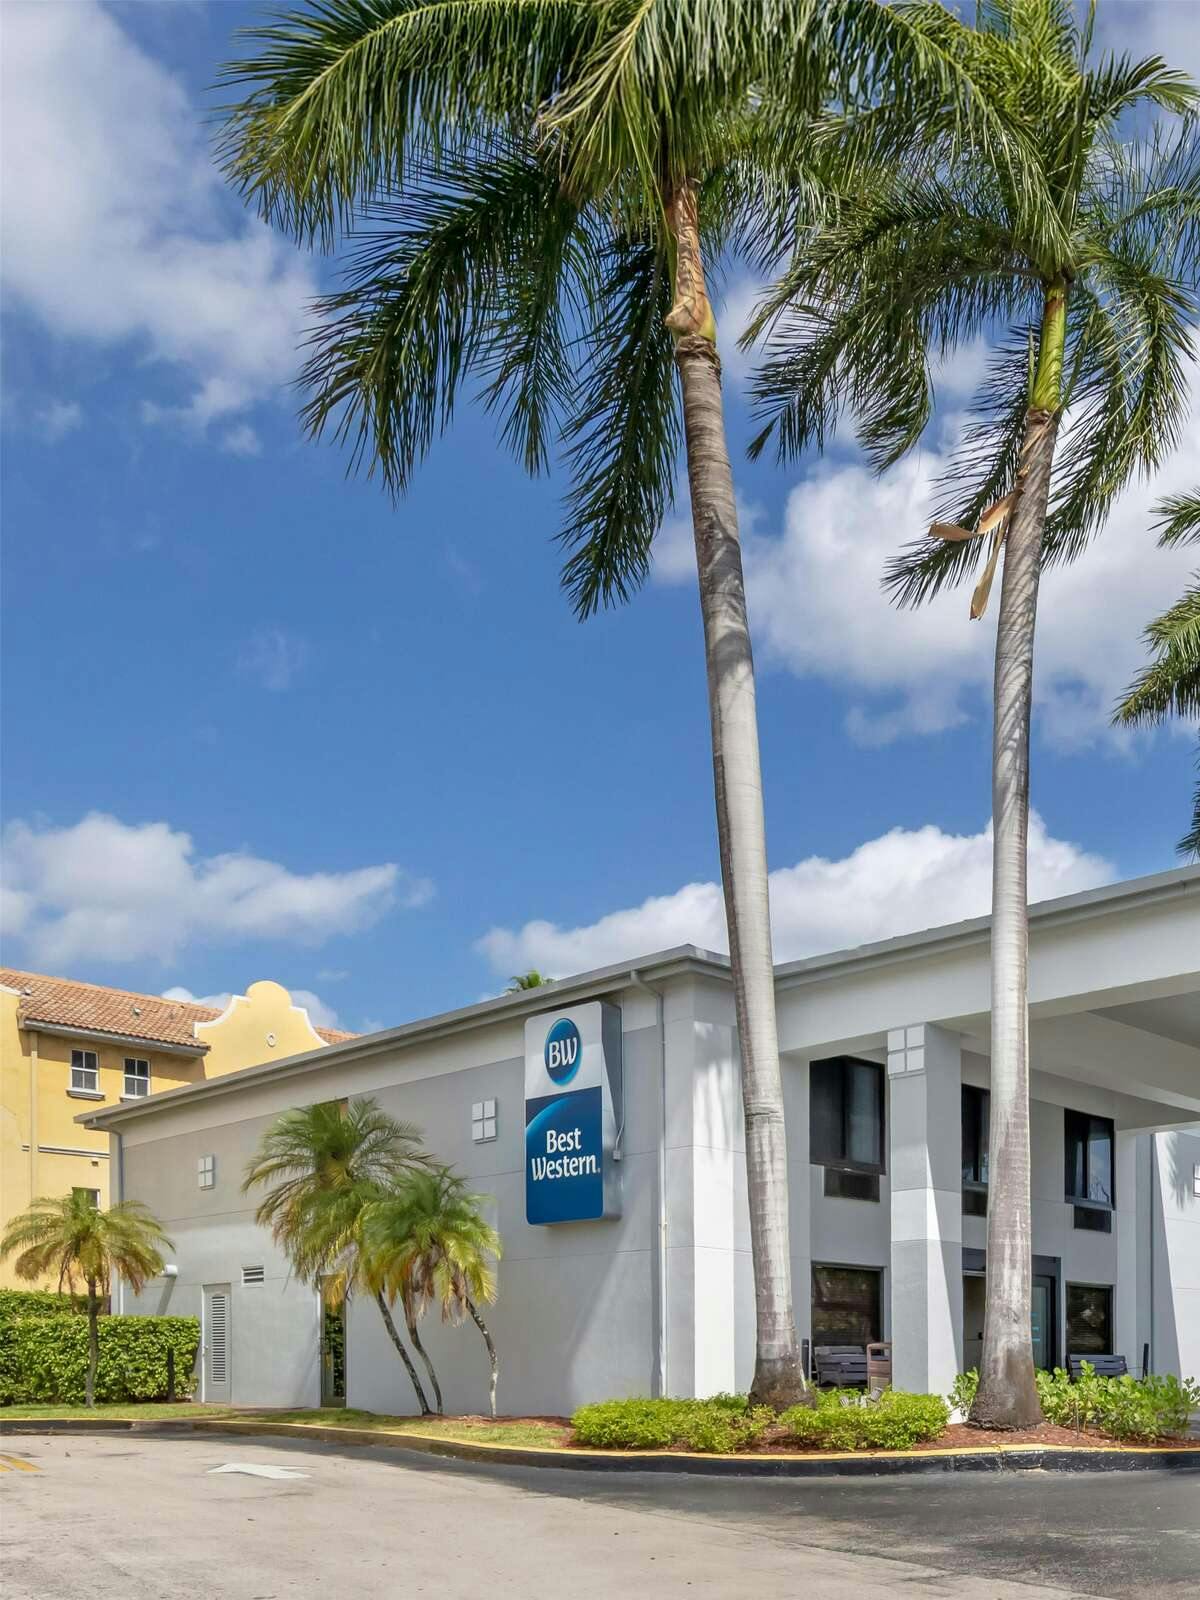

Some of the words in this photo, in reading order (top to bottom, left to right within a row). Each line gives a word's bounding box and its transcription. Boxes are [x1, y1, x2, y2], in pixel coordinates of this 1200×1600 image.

[549, 1037, 577, 1068] BW
[546, 1128, 581, 1153] Best
[531, 1154, 597, 1181] Western
